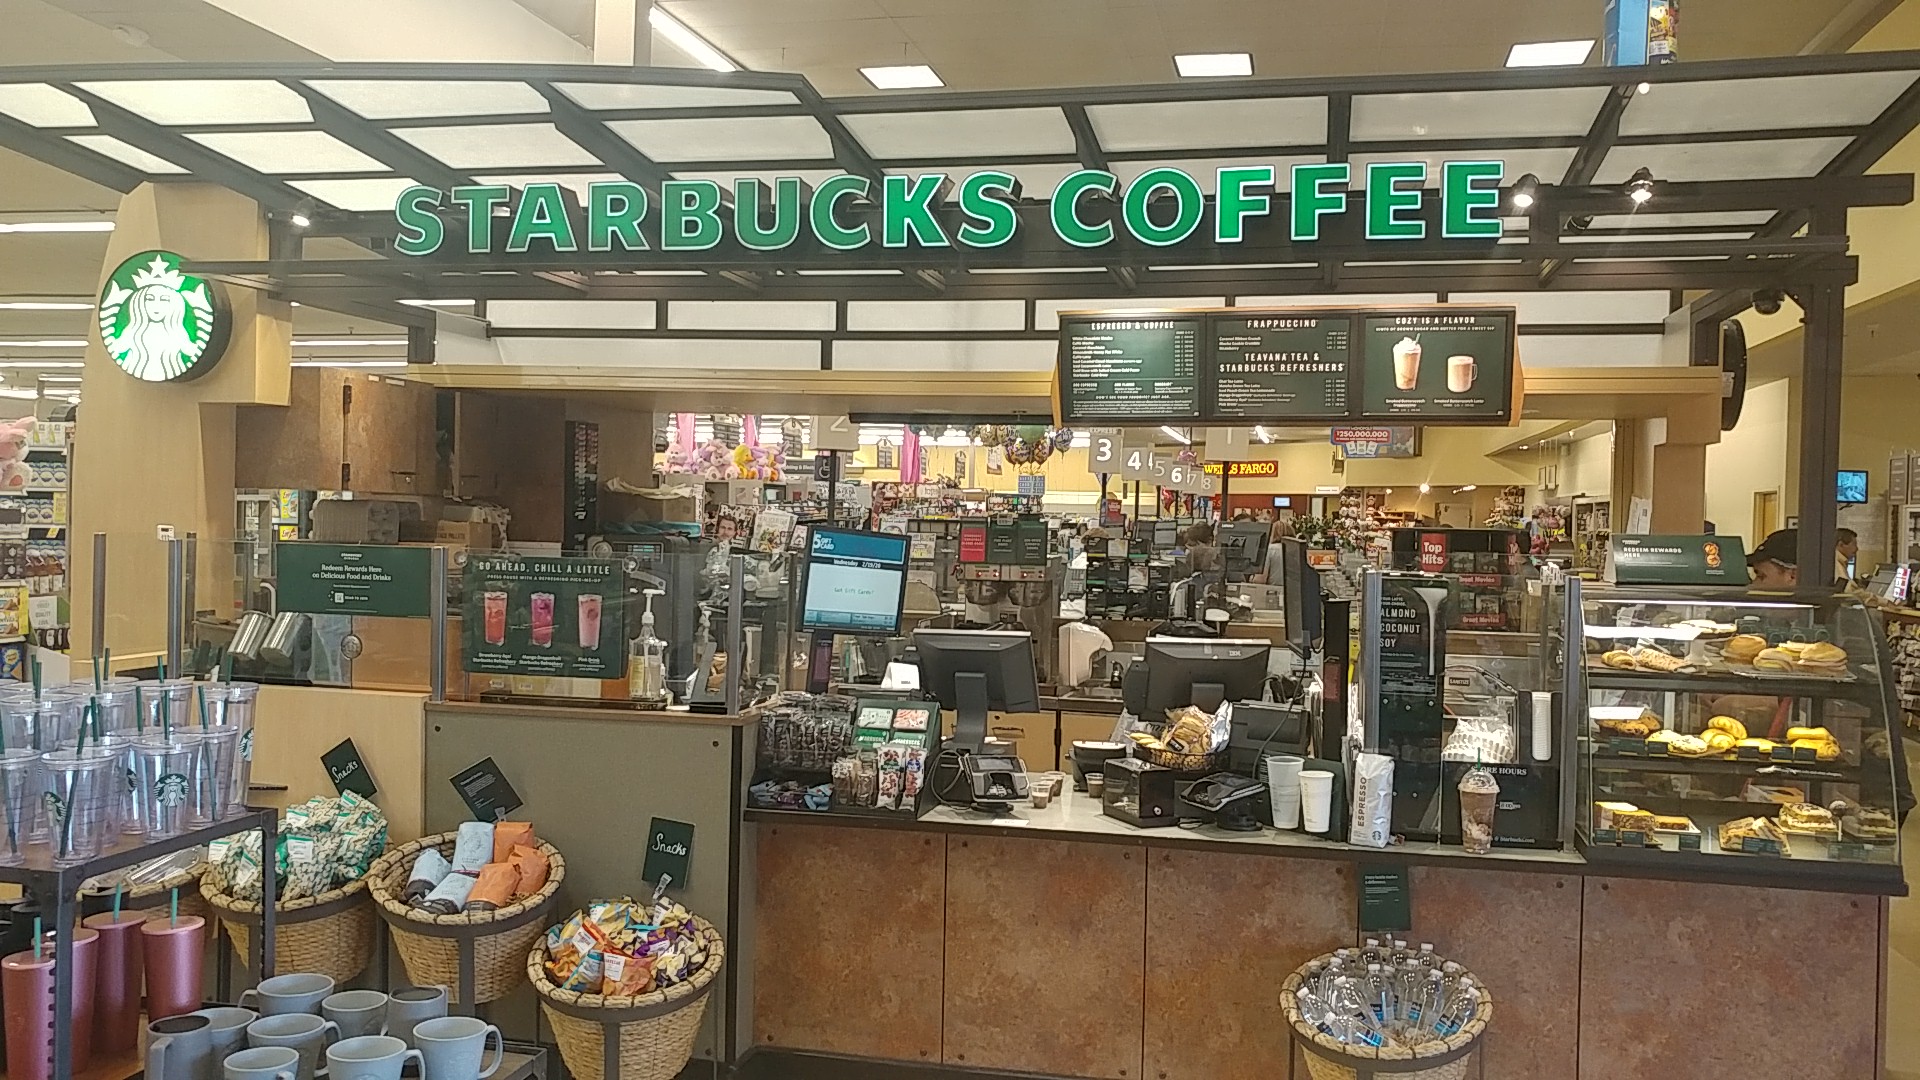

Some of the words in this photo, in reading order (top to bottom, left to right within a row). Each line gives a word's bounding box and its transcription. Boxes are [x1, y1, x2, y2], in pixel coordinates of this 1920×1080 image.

[394, 170, 1019, 255] STARBUCKS
[1050, 160, 1504, 248] COFFEE
[1091, 322, 1132, 330] ESPRESSO
[1144, 321, 1174, 329] COFFEE
[1247, 320, 1316, 328] FRAPPUCCINO
[1291, 353, 1308, 361] TEA
[1220, 364, 1275, 372] STARBUCKS
[1096, 438, 1112, 461] 3
[1128, 451, 1142, 470] 4
[1155, 460, 1166, 476] 5
[1204, 464, 1238, 474] WELS
[1239, 463, 1275, 474] FARGO
[1171, 467, 1182, 483] 6
[1189, 473, 1197, 486] 7
[1203, 478, 1211, 490] 8
[1423, 542, 1442, 554] Top
[834, 559, 858, 567] Wednesday
[1422, 554, 1444, 564] Hits
[479, 562, 491, 570] GO
[495, 562, 529, 573] AHEAD,
[534, 565, 562, 573] CHILL
[567, 565, 572, 573] A
[577, 565, 610, 575] LITTLE
[321, 572, 346, 580] Delicious
[1381, 608, 1416, 618] ALMOND
[1380, 623, 1421, 633] COCONUT
[1380, 638, 1396, 647] SOY
[331, 760, 358, 784] Snacks
[1499, 767, 1527, 775] HOURS
[1358, 777, 1367, 827] ESPRESSO
[652, 833, 687, 855] Snacks
